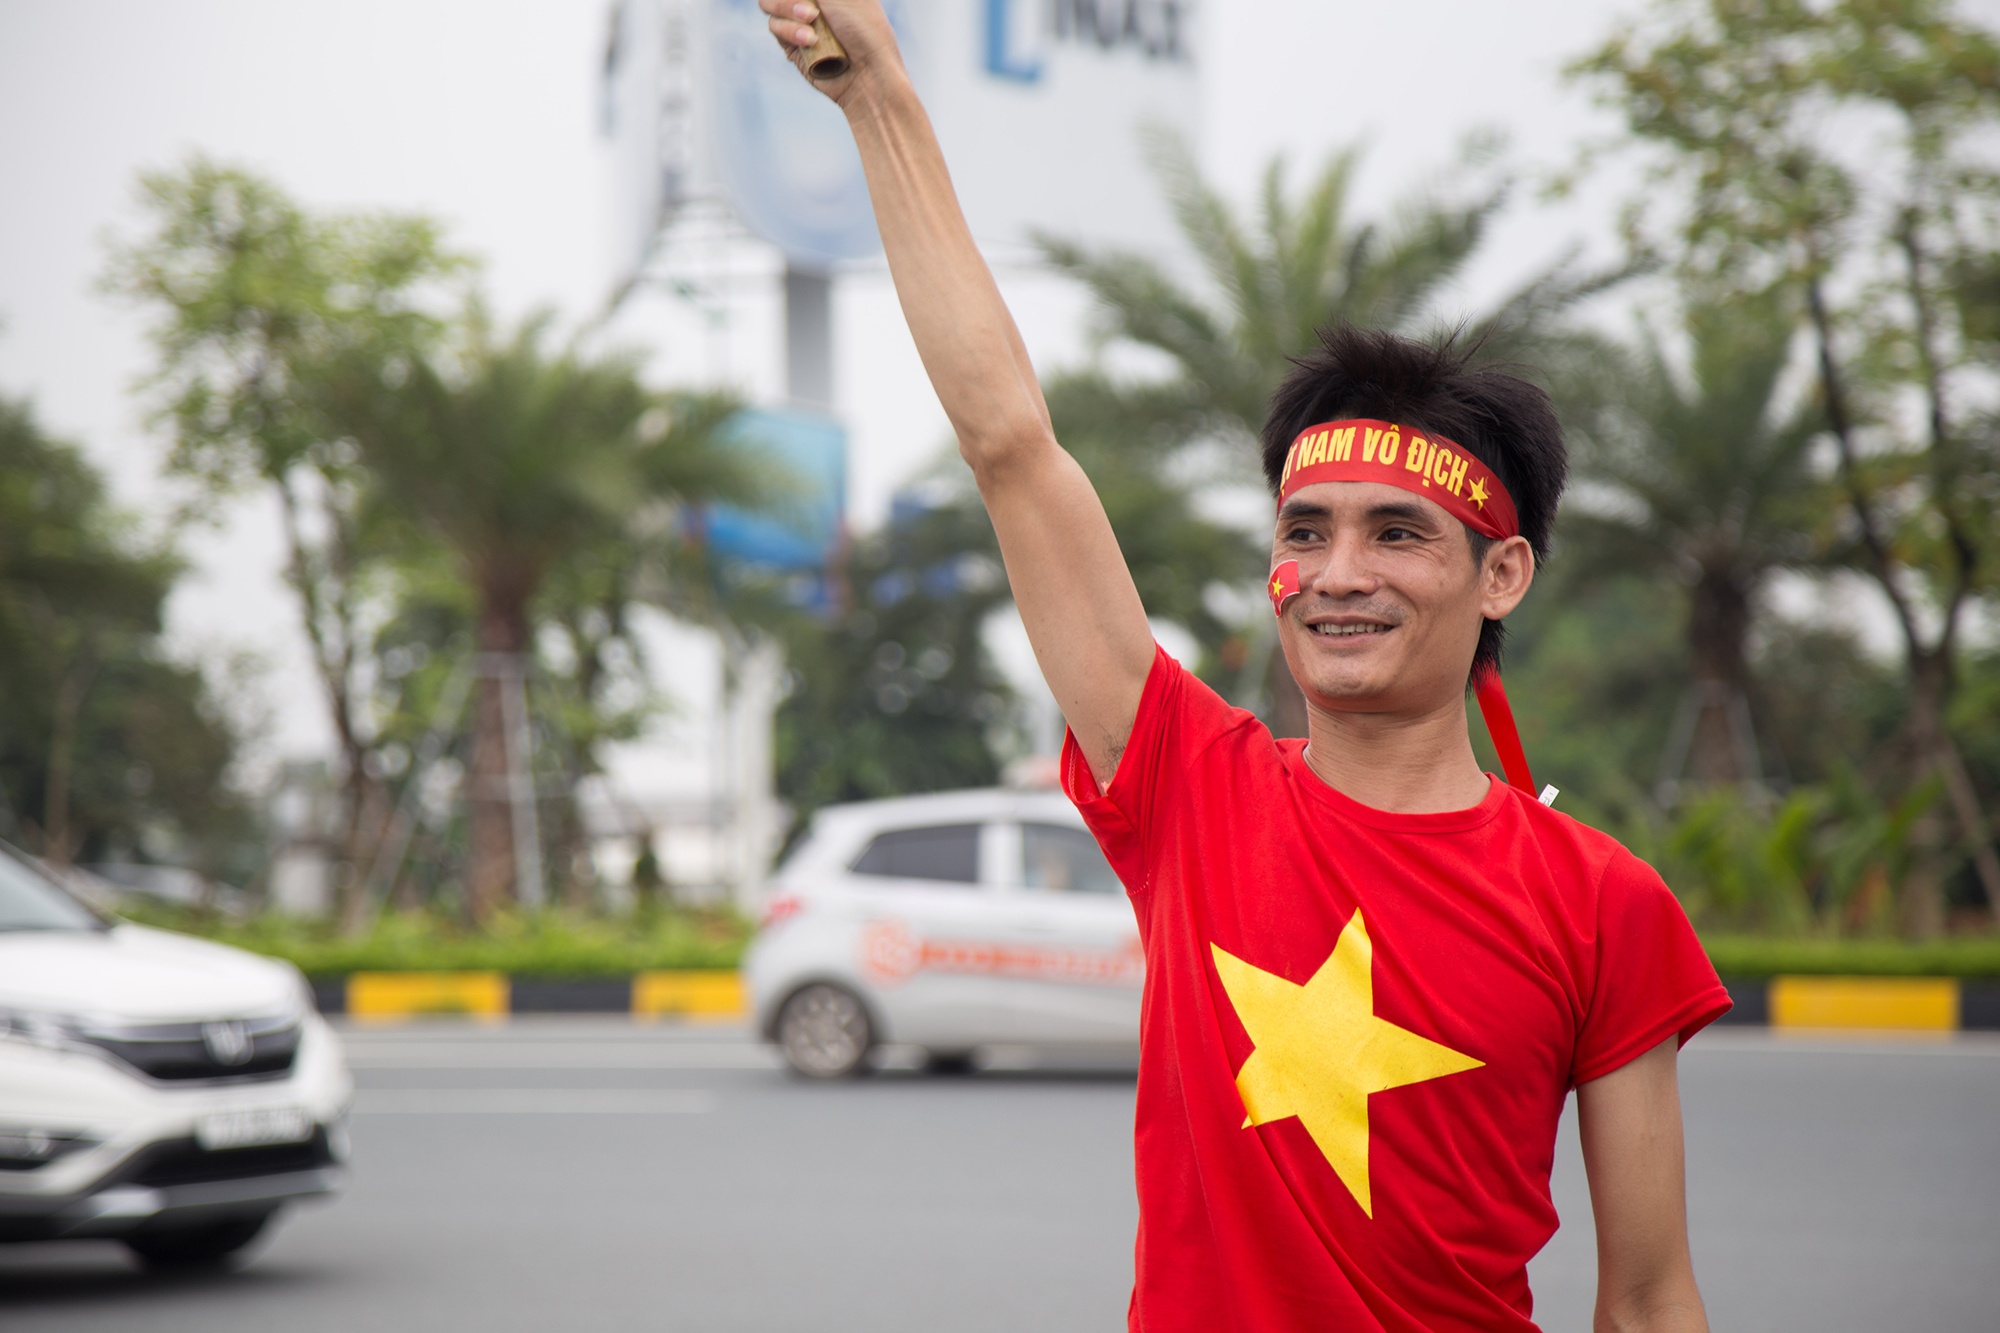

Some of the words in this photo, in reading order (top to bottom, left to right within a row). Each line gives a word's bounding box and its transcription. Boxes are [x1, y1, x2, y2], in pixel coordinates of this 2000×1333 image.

[1296, 427, 1356, 472] NAM
[1362, 424, 1400, 465] VÔ
[1405, 436, 1469, 497] ĐỊCH
